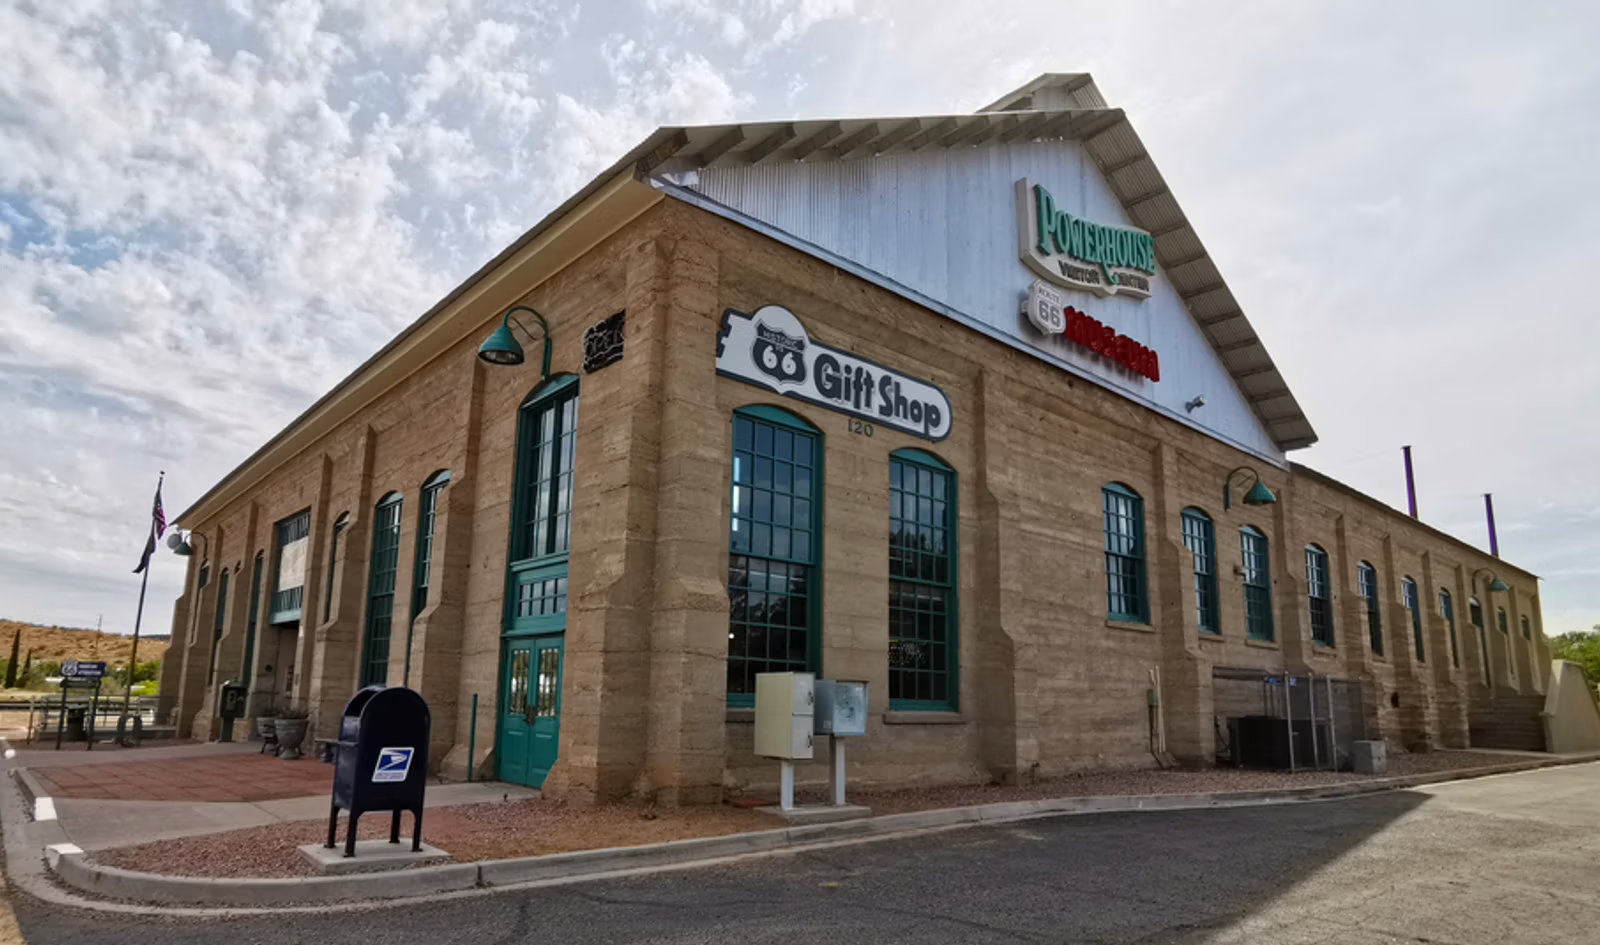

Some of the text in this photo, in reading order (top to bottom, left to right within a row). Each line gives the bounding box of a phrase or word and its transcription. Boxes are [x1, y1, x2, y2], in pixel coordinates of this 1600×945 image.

[1034, 184, 1156, 282] POWERHOUSE
[1038, 300, 1060, 328] 66
[762, 345, 797, 376] 66
[814, 353, 941, 437] Gift Shop
[848, 418, 874, 437] 120
